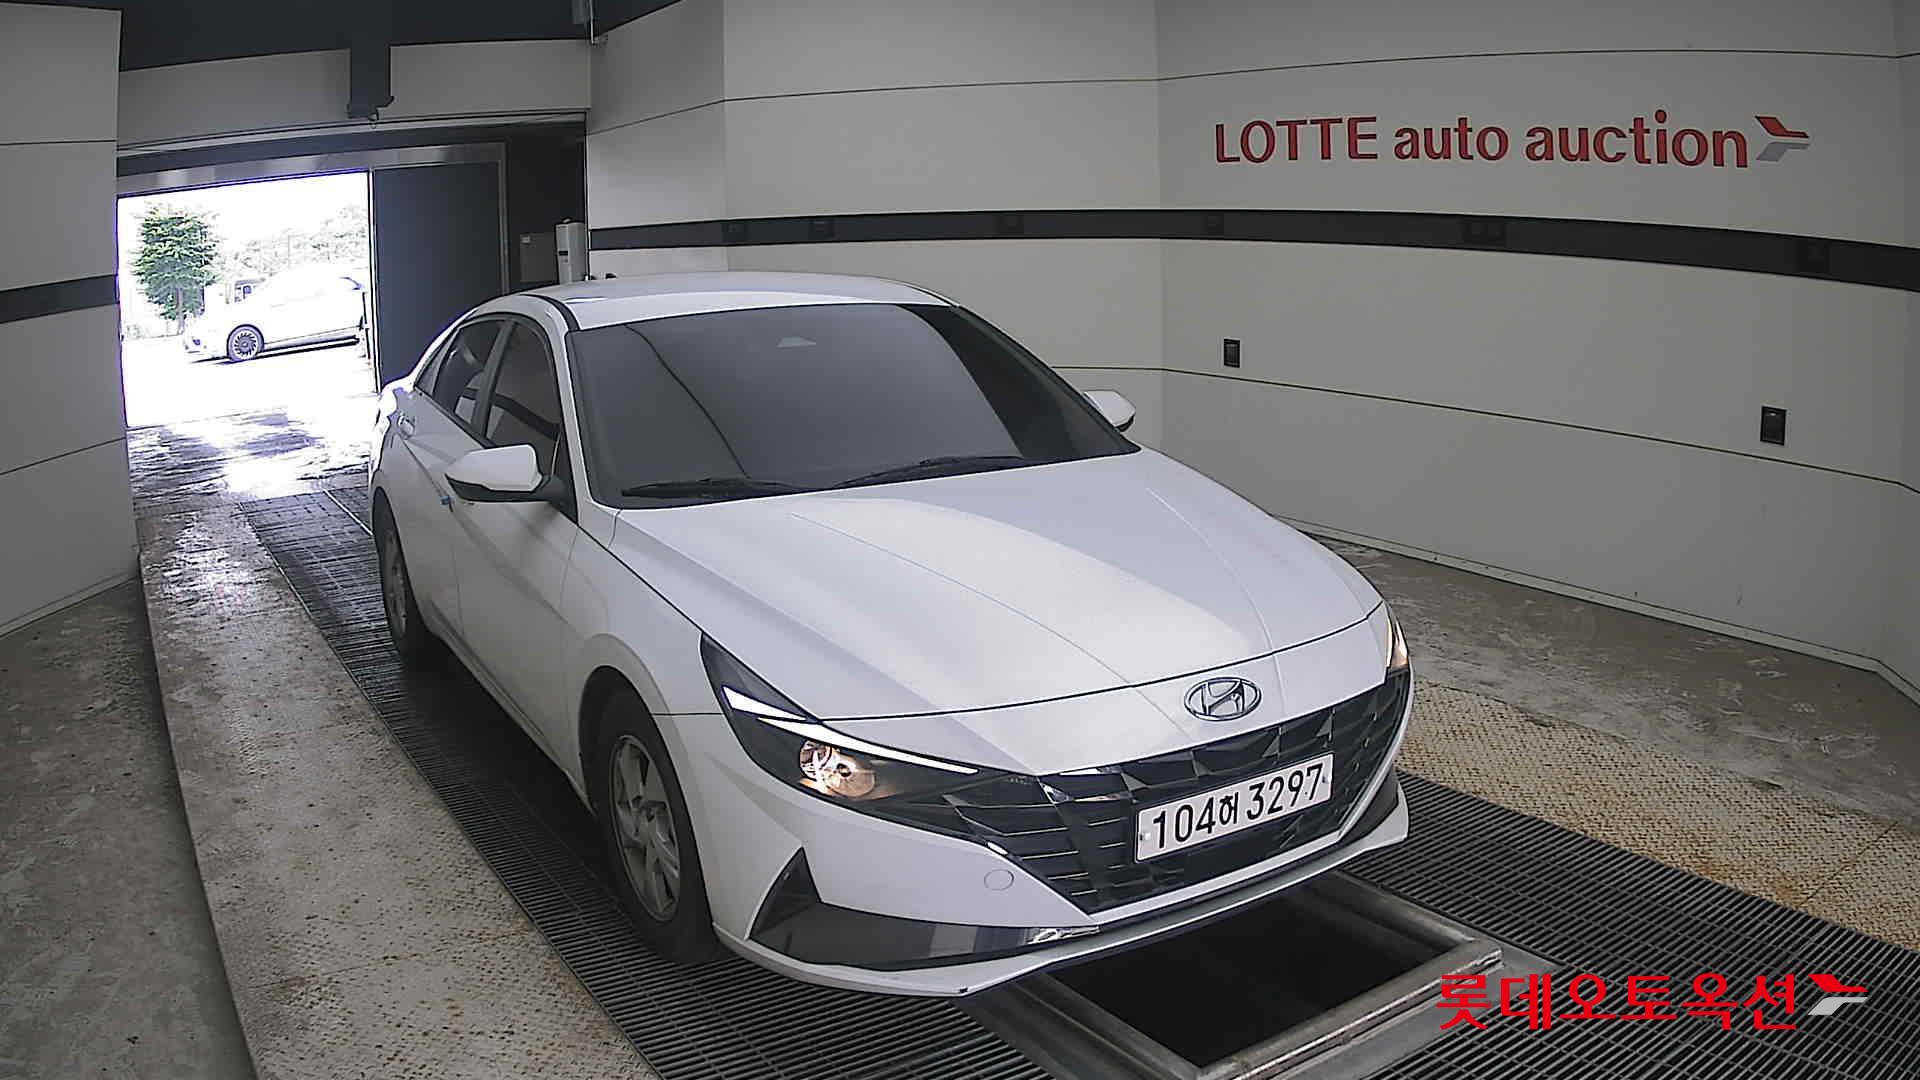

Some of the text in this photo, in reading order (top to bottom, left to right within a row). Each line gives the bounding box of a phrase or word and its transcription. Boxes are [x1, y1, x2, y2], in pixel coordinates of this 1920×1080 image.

[1215, 110, 1748, 168] LOTTE auto auction
[1153, 763, 1323, 848] 104허 3297
